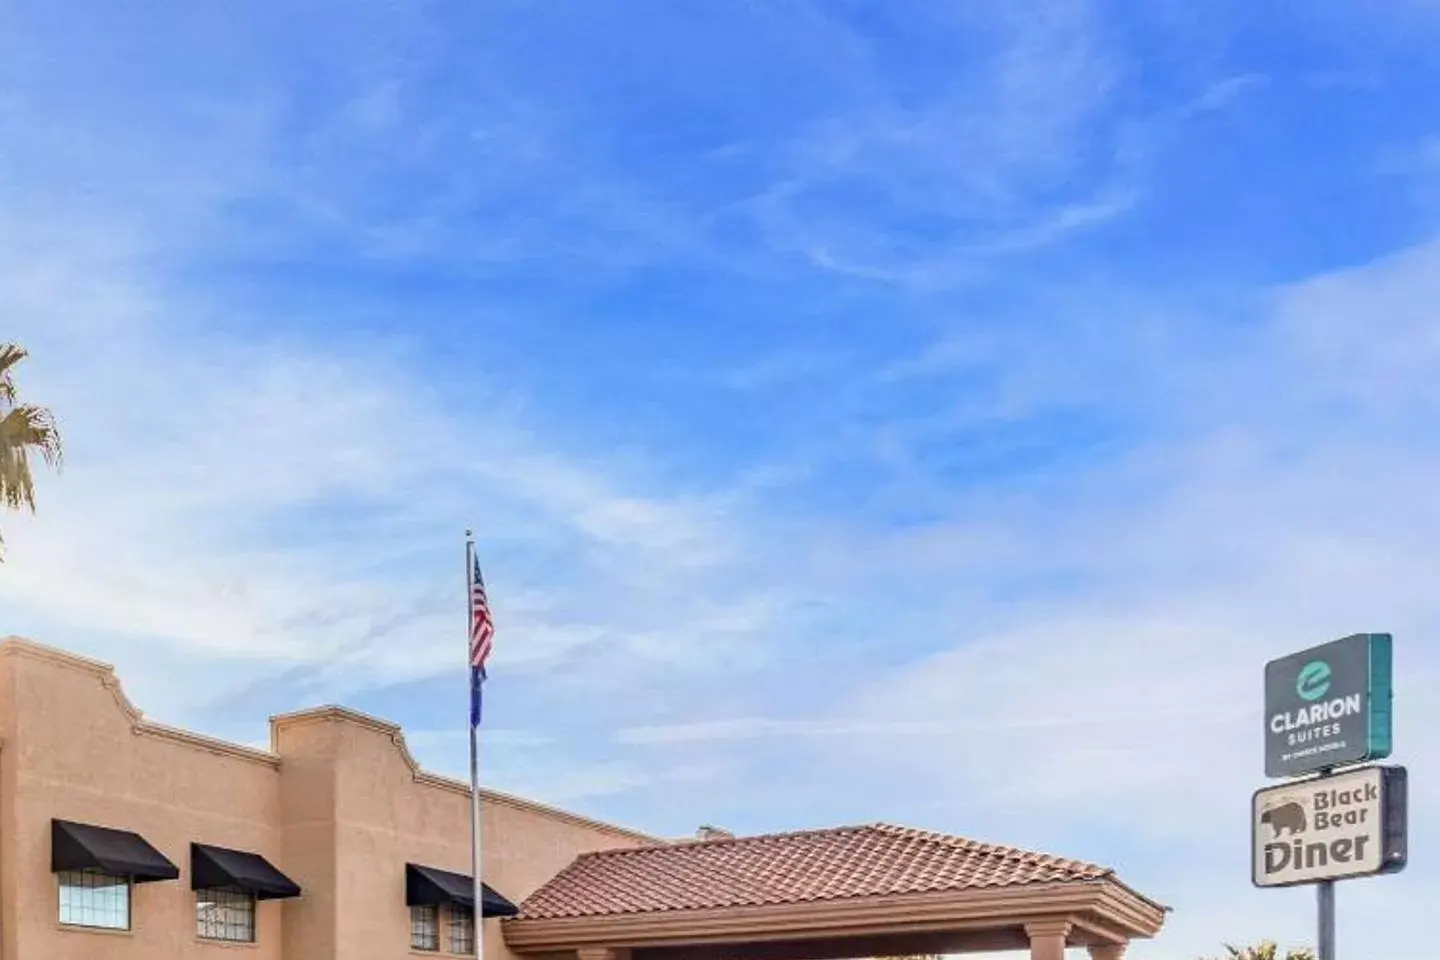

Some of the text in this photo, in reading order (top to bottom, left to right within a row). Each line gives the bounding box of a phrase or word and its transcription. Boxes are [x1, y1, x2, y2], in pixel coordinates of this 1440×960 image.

[1270, 693, 1361, 734] CLARION
[1287, 723, 1341, 746] SUITES
[1313, 783, 1378, 811] Black
[1314, 807, 1368, 831] Bear
[1264, 834, 1370, 875] Diner
